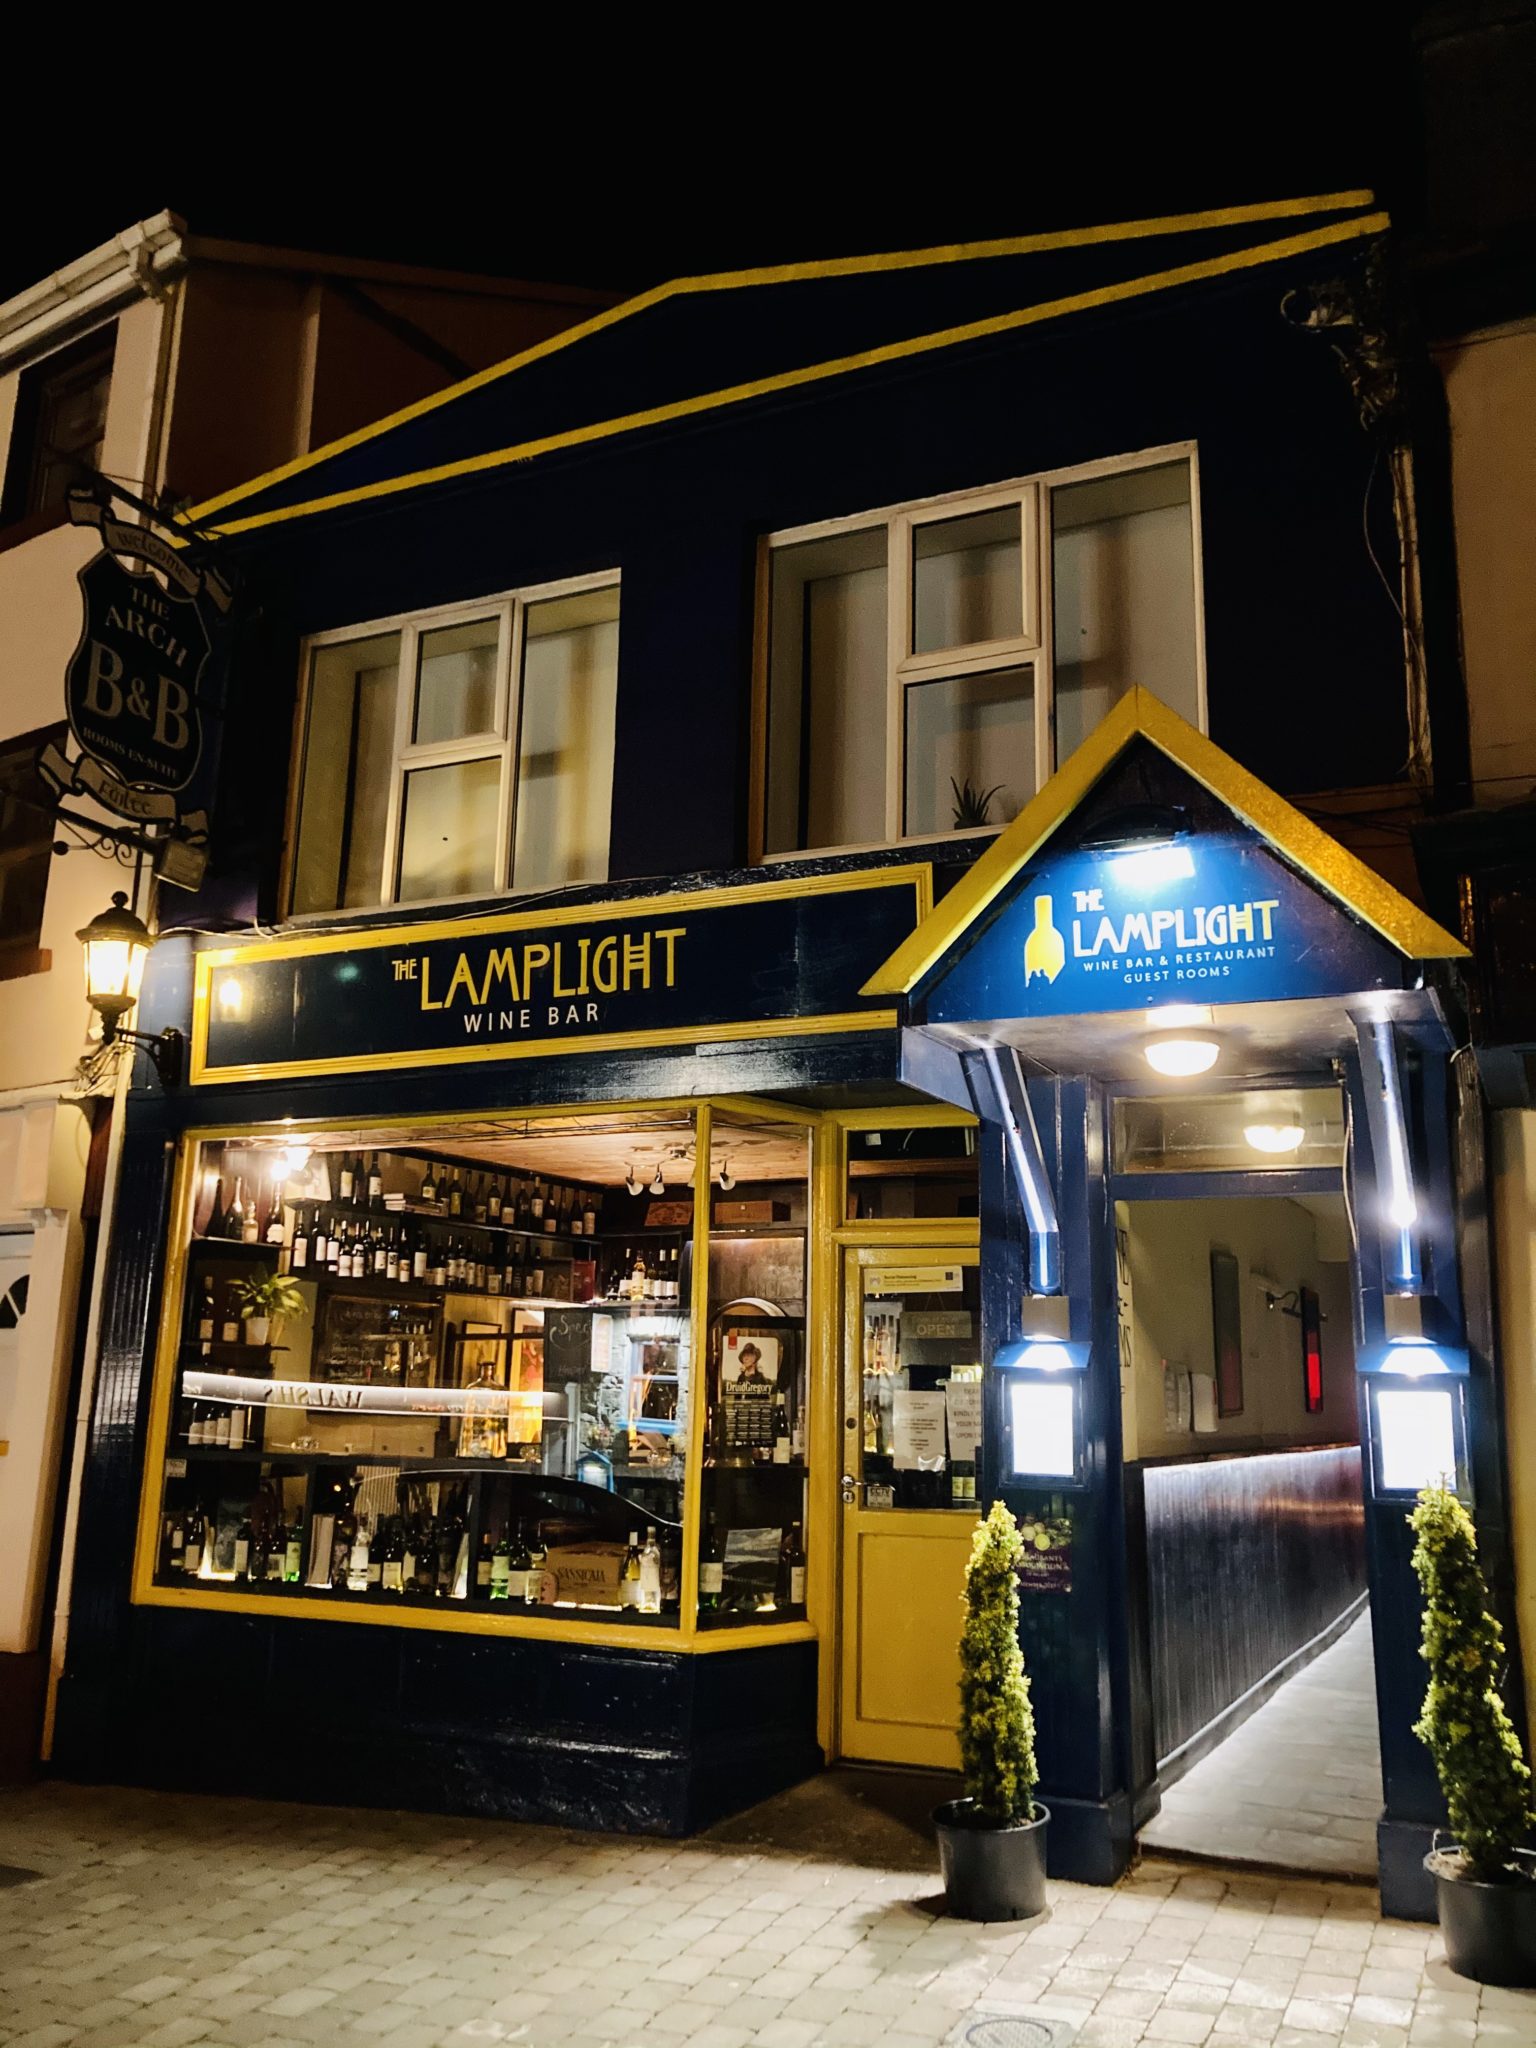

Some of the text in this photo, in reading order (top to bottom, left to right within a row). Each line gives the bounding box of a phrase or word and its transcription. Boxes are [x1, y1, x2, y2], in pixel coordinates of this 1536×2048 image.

[129, 584, 170, 620] THE
[105, 605, 188, 667] ARCH
[82, 640, 189, 750] B&B
[83, 727, 126, 753] ROOMS
[1072, 889, 1104, 912] THE
[1072, 900, 1279, 957] LAMPLIGHT
[392, 928, 687, 1011] THE LAMPLIGHT
[1083, 946, 1276, 972] WINE BAR & RESTAURANT
[1124, 965, 1230, 984] GUEST ROOMS
[464, 1003, 599, 1033] WINE BAR
[917, 1324, 955, 1336] OPEN
